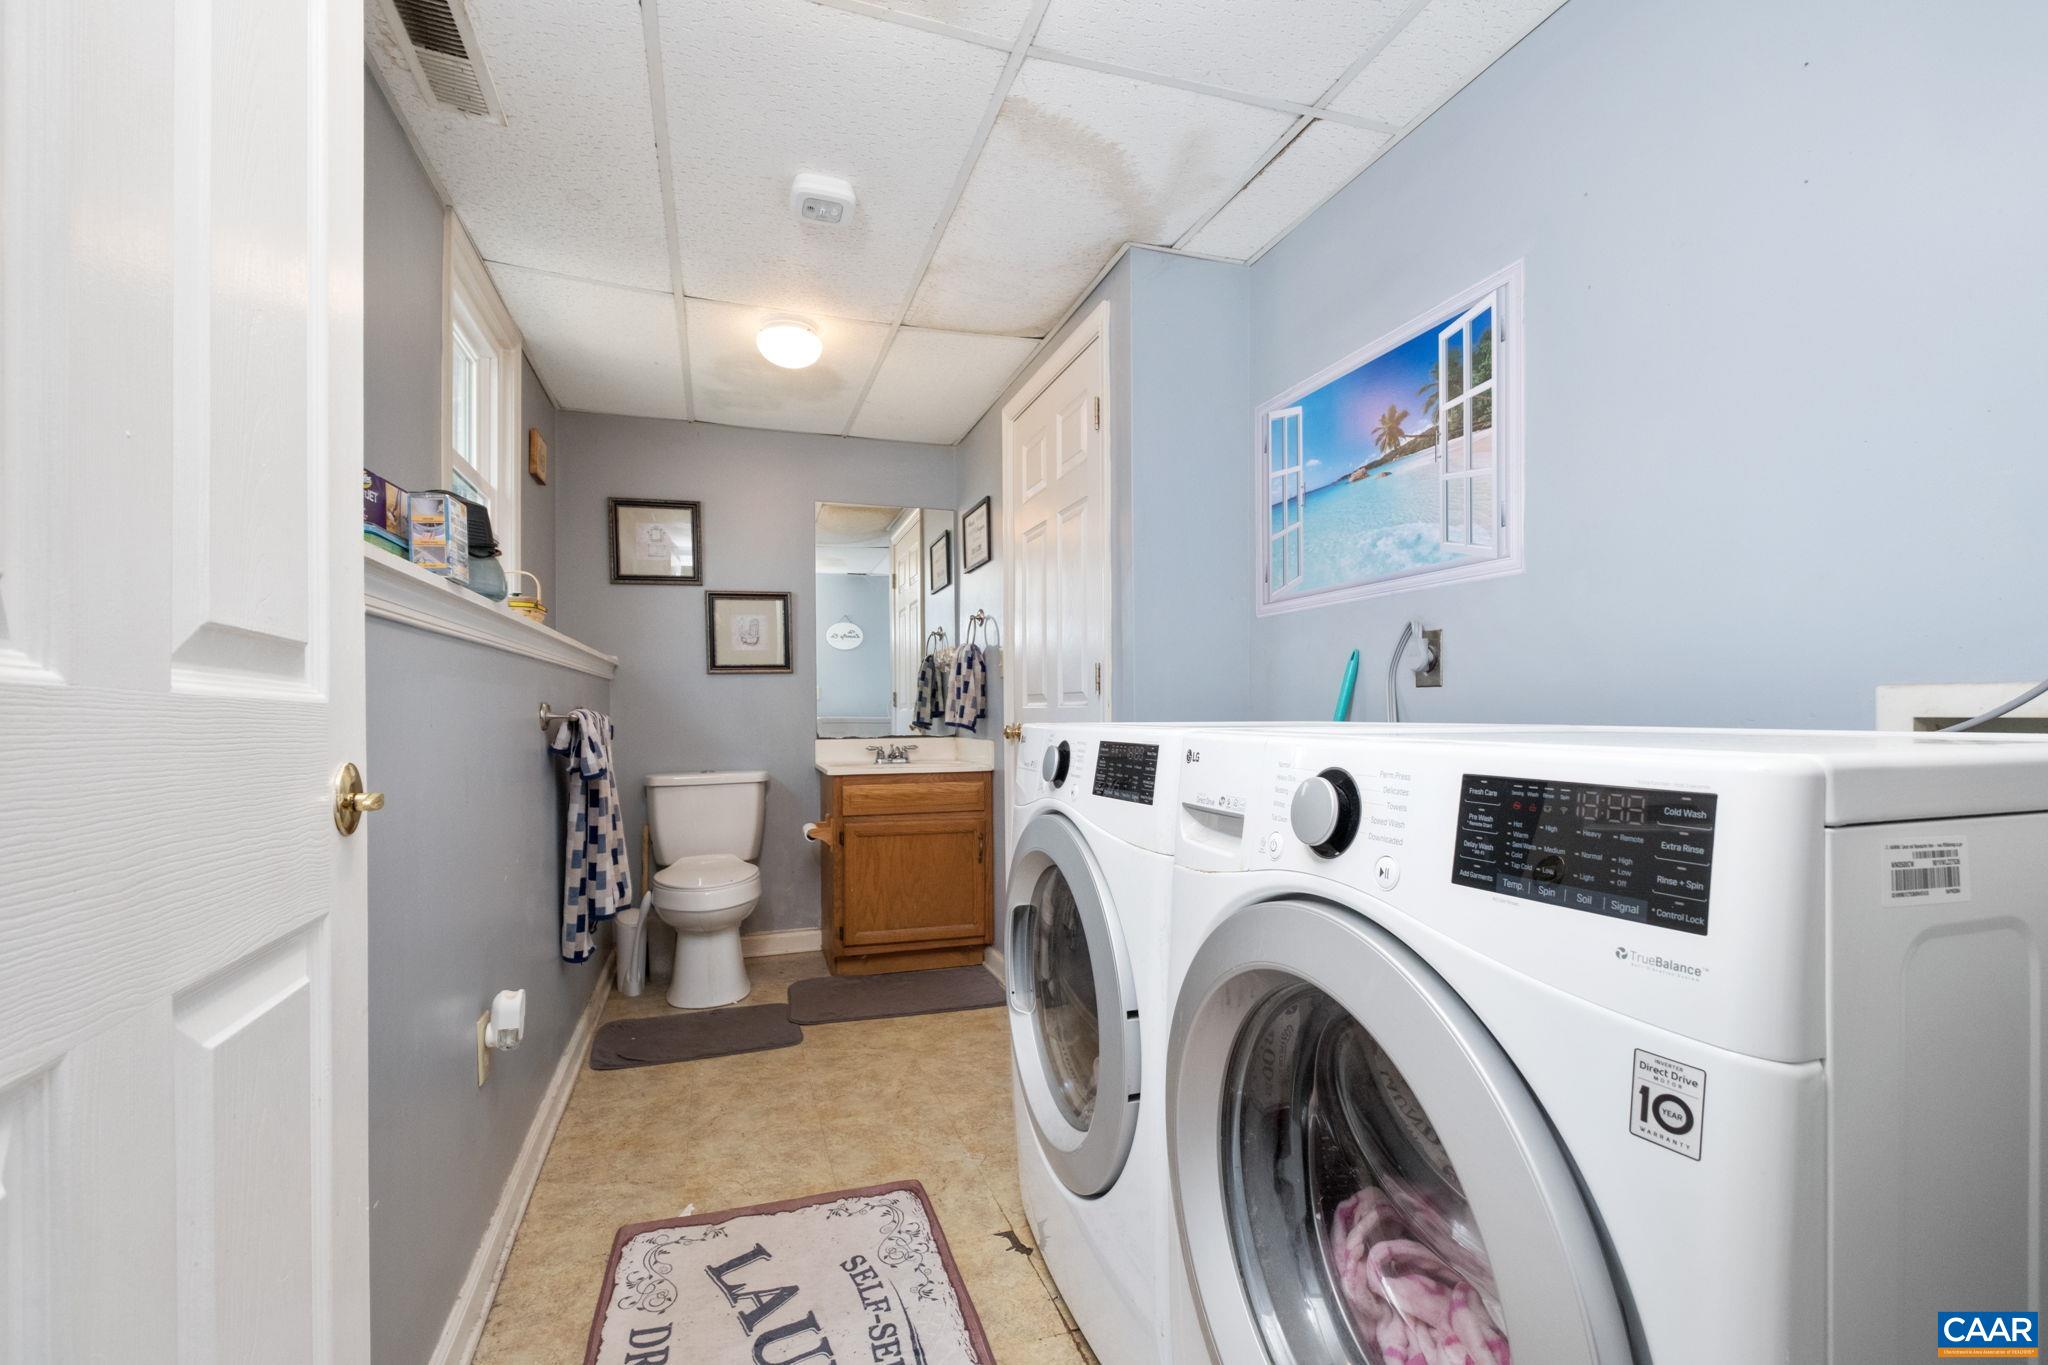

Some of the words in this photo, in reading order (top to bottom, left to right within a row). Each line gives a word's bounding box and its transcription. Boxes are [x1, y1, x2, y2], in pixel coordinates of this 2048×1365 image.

[1479, 814, 1493, 822] Wash
[1664, 807, 1681, 816] Cold
[1683, 809, 1707, 819] Wash
[1583, 830, 1601, 839] Heavy
[1620, 834, 1644, 843] Remote
[1464, 840, 1478, 849] Delay
[1479, 843, 1494, 851] Wash
[1544, 846, 1565, 854] Medium
[1661, 841, 1681, 851] Extra
[1683, 844, 1704, 854] Rinse
[1581, 852, 1603, 860] Normal
[1619, 857, 1632, 865] High
[1542, 867, 1554, 875] Low
[1617, 868, 1631, 876] Low
[1470, 872, 1493, 882] Garments
[1580, 874, 1594, 882] Light
[1657, 875, 1678, 886] Rinse
[1686, 881, 1704, 890] Spin
[1538, 886, 1555, 897] Spin
[1577, 894, 1592, 904] Soil
[1611, 901, 1639, 914] Signal
[1656, 909, 1684, 921] Control
[1686, 914, 1704, 925] Lock
[1654, 1060, 1683, 1072] INVERTER
[1640, 1060, 1668, 1078] Direct
[1671, 1071, 1698, 1087] Drive
[1654, 1076, 1682, 1089] MOTOR
[1639, 1085, 1694, 1135] 10
[1662, 1108, 1682, 1120] YEAR
[1640, 1126, 1690, 1150] WARRANTY
[704, 1243, 838, 1365] LAU
[840, 1255, 905, 1365] SELF-SE
